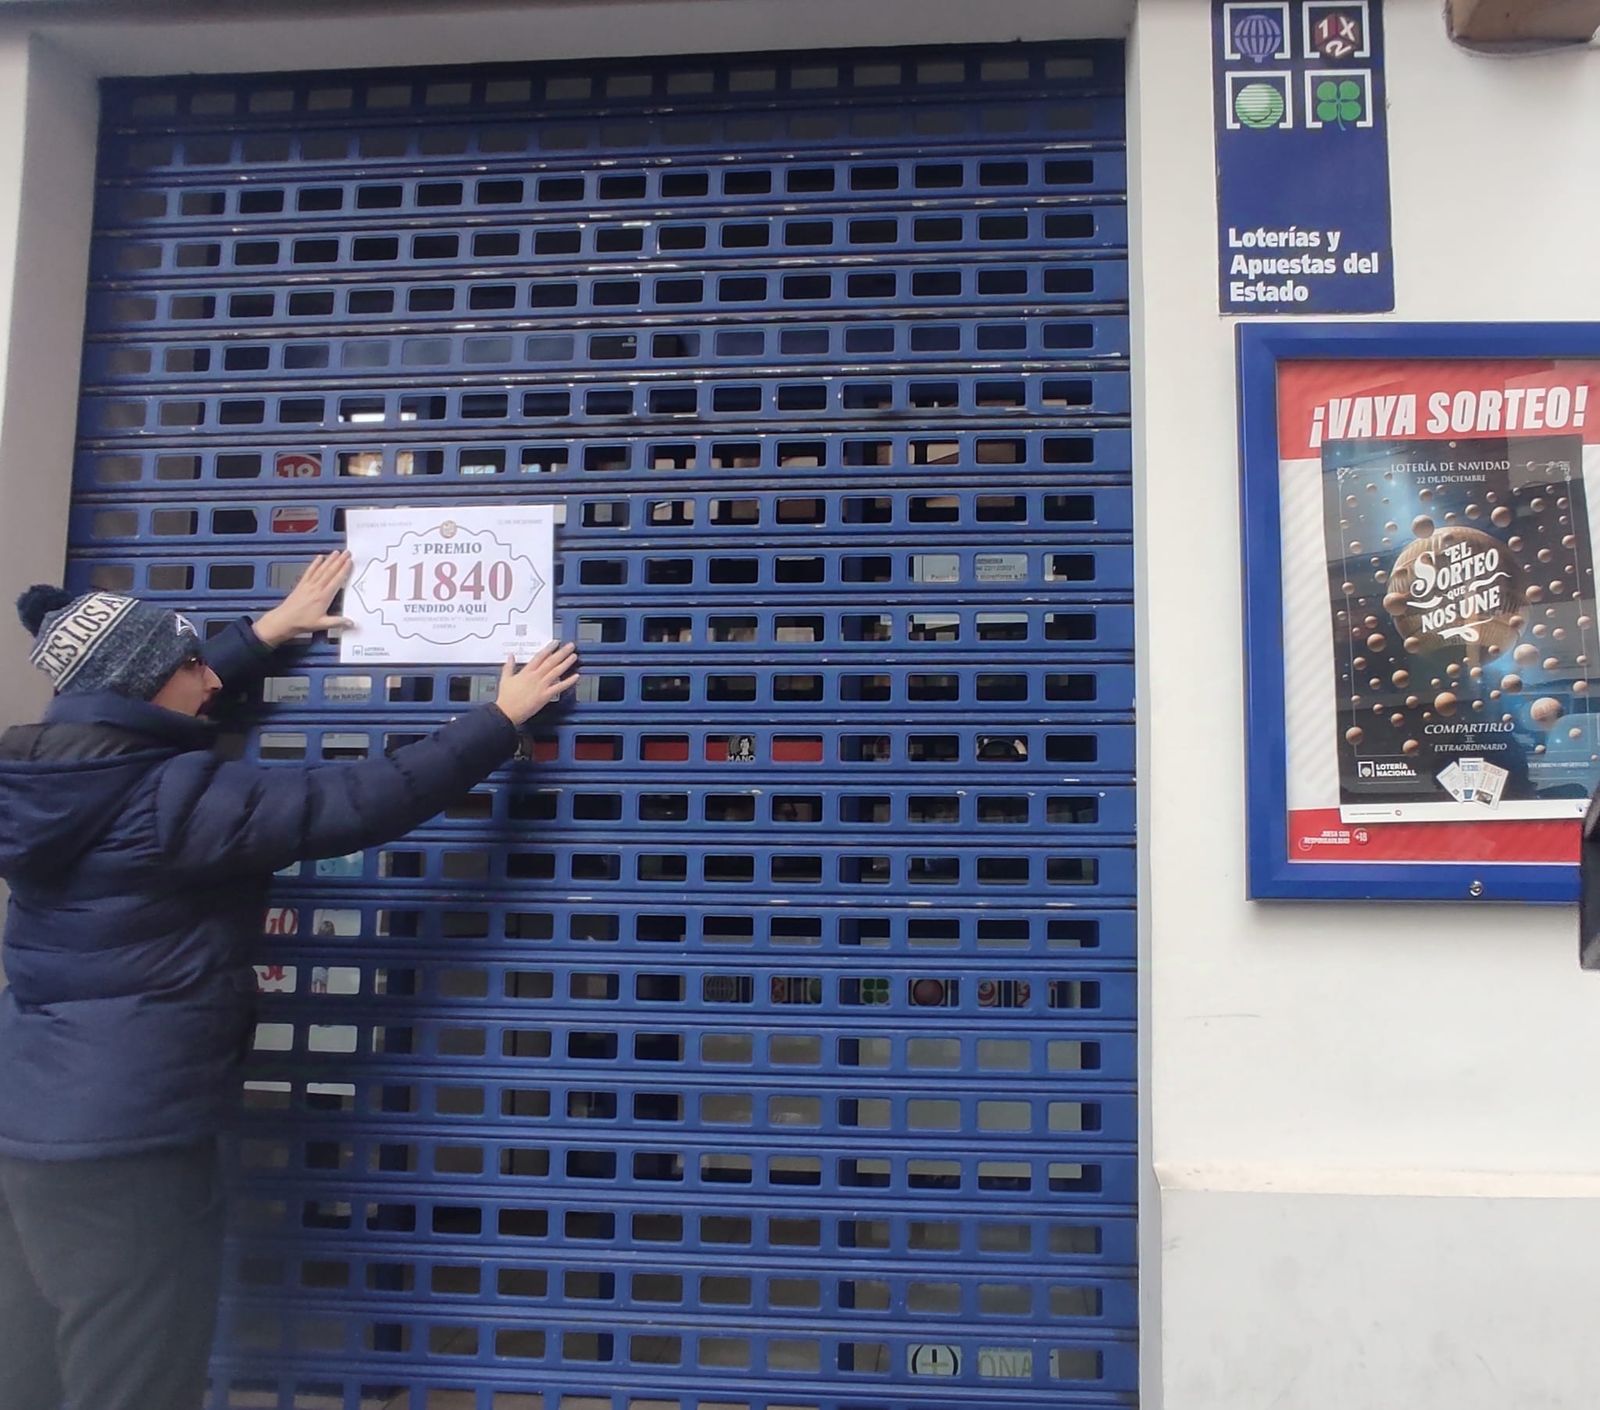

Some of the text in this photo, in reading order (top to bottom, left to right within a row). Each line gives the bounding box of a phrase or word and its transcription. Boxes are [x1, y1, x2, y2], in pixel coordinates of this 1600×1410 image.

[1228, 226, 1341, 252] Loterías y
[1230, 252, 1378, 279] Apuestas del
[1230, 280, 1309, 302] Estado
[1308, 385, 1589, 448] ¡VAYA SORTEO!
[1391, 460, 1511, 473] LOTERÍA DE NAVIDAD
[1441, 474, 1487, 484] DICIEMBRE
[424, 542, 482, 554] PREMIO
[1443, 541, 1472, 563] EL
[382, 560, 513, 602] 11840
[1443, 585, 1467, 600] QUE
[404, 602, 487, 615] VENDIDO AQUÍ
[1421, 585, 1500, 633] NOS UNE
[1424, 721, 1515, 735] COMPARTIRLO
[1434, 743, 1507, 752] EXTRAORDINARIO
[1376, 762, 1408, 770] LOTERÍA
[1376, 769, 1417, 777] NACIONAL
